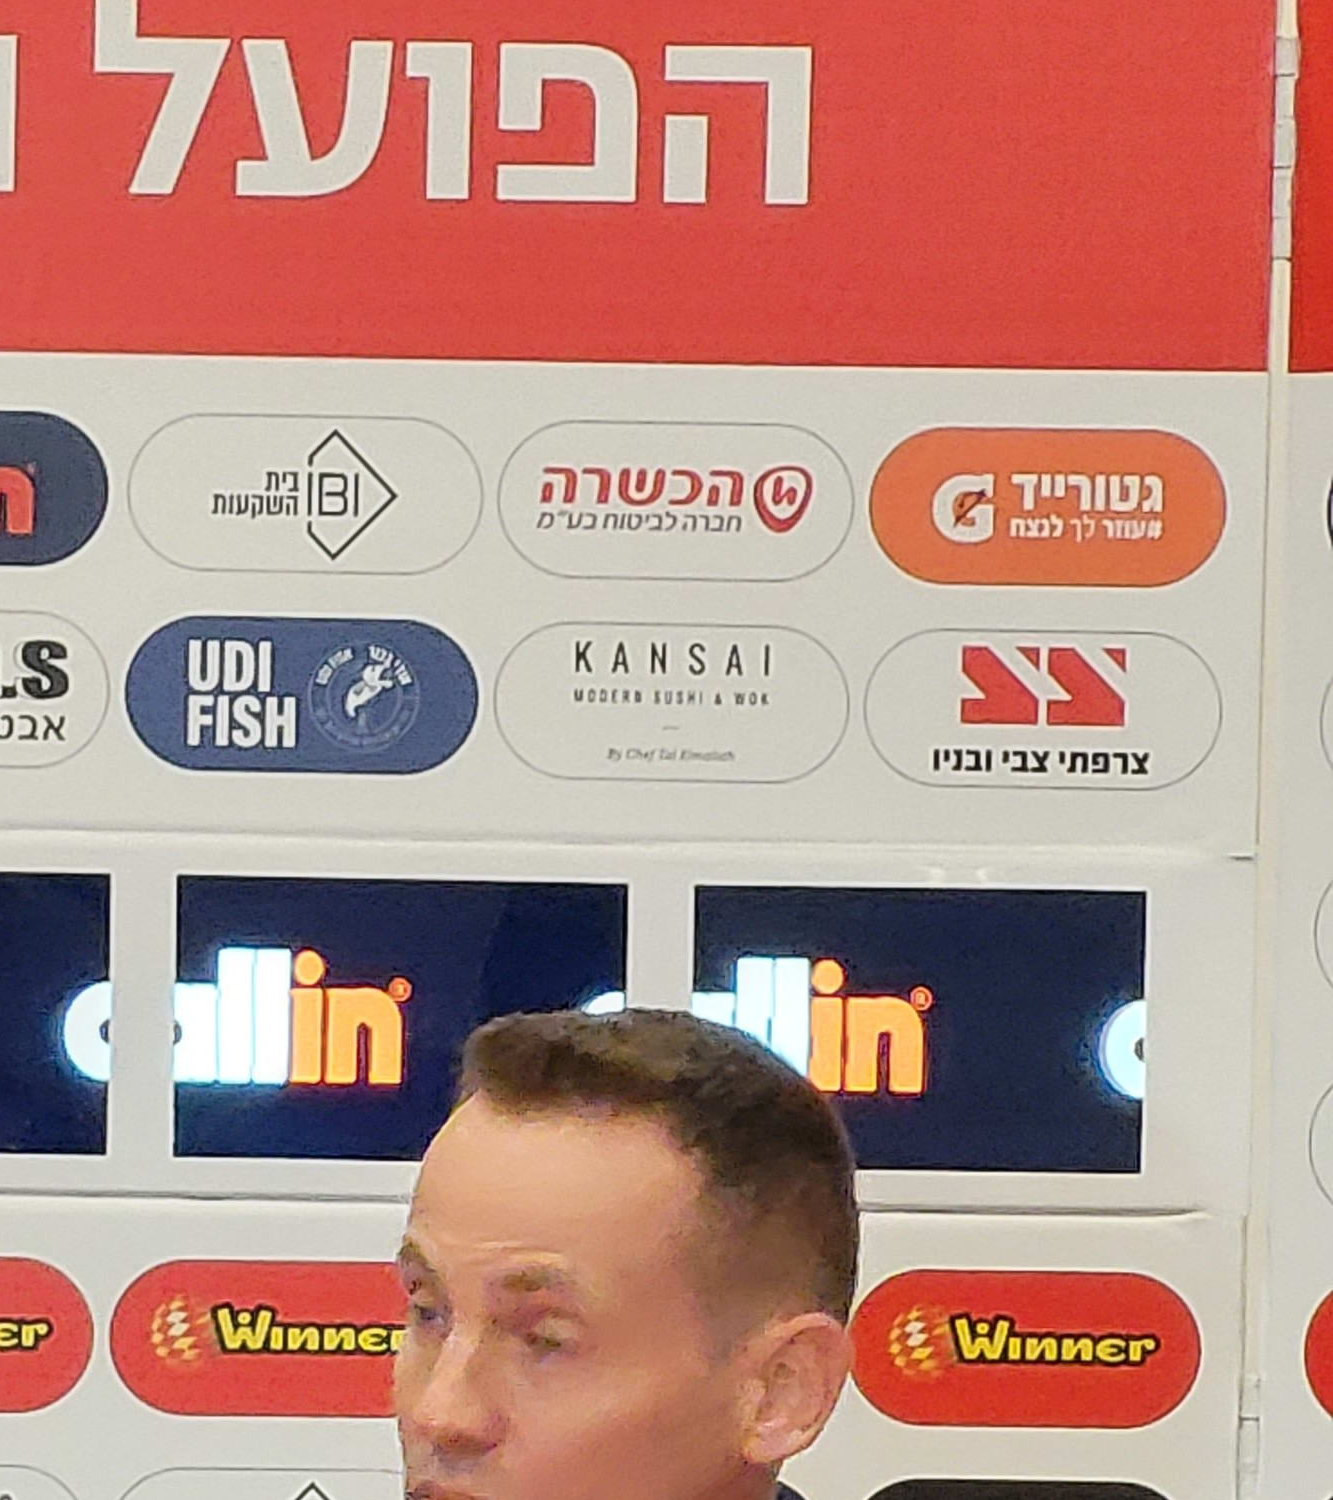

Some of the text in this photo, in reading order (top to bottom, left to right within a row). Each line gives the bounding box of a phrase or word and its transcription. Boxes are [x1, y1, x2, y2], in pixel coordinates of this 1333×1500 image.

[94, 0, 814, 206] הפועל
[265, 472, 299, 492] בית
[541, 467, 744, 506] הכשרה
[1011, 472, 1162, 516] גטורייד
[212, 494, 298, 518] השקעות
[603, 511, 677, 531] לביטוח
[682, 515, 741, 532] חברה
[1010, 515, 1063, 538] לנצח
[1070, 512, 1101, 542] לך
[189, 640, 271, 696] UDI
[576, 642, 769, 676] KANSAI
[654, 691, 702, 704] SUSHI
[735, 692, 768, 705] WOK
[187, 690, 299, 747] FISH
[934, 749, 1149, 774] צרפתי צבי ובניו
[945, 1314, 1160, 1366] Winner
